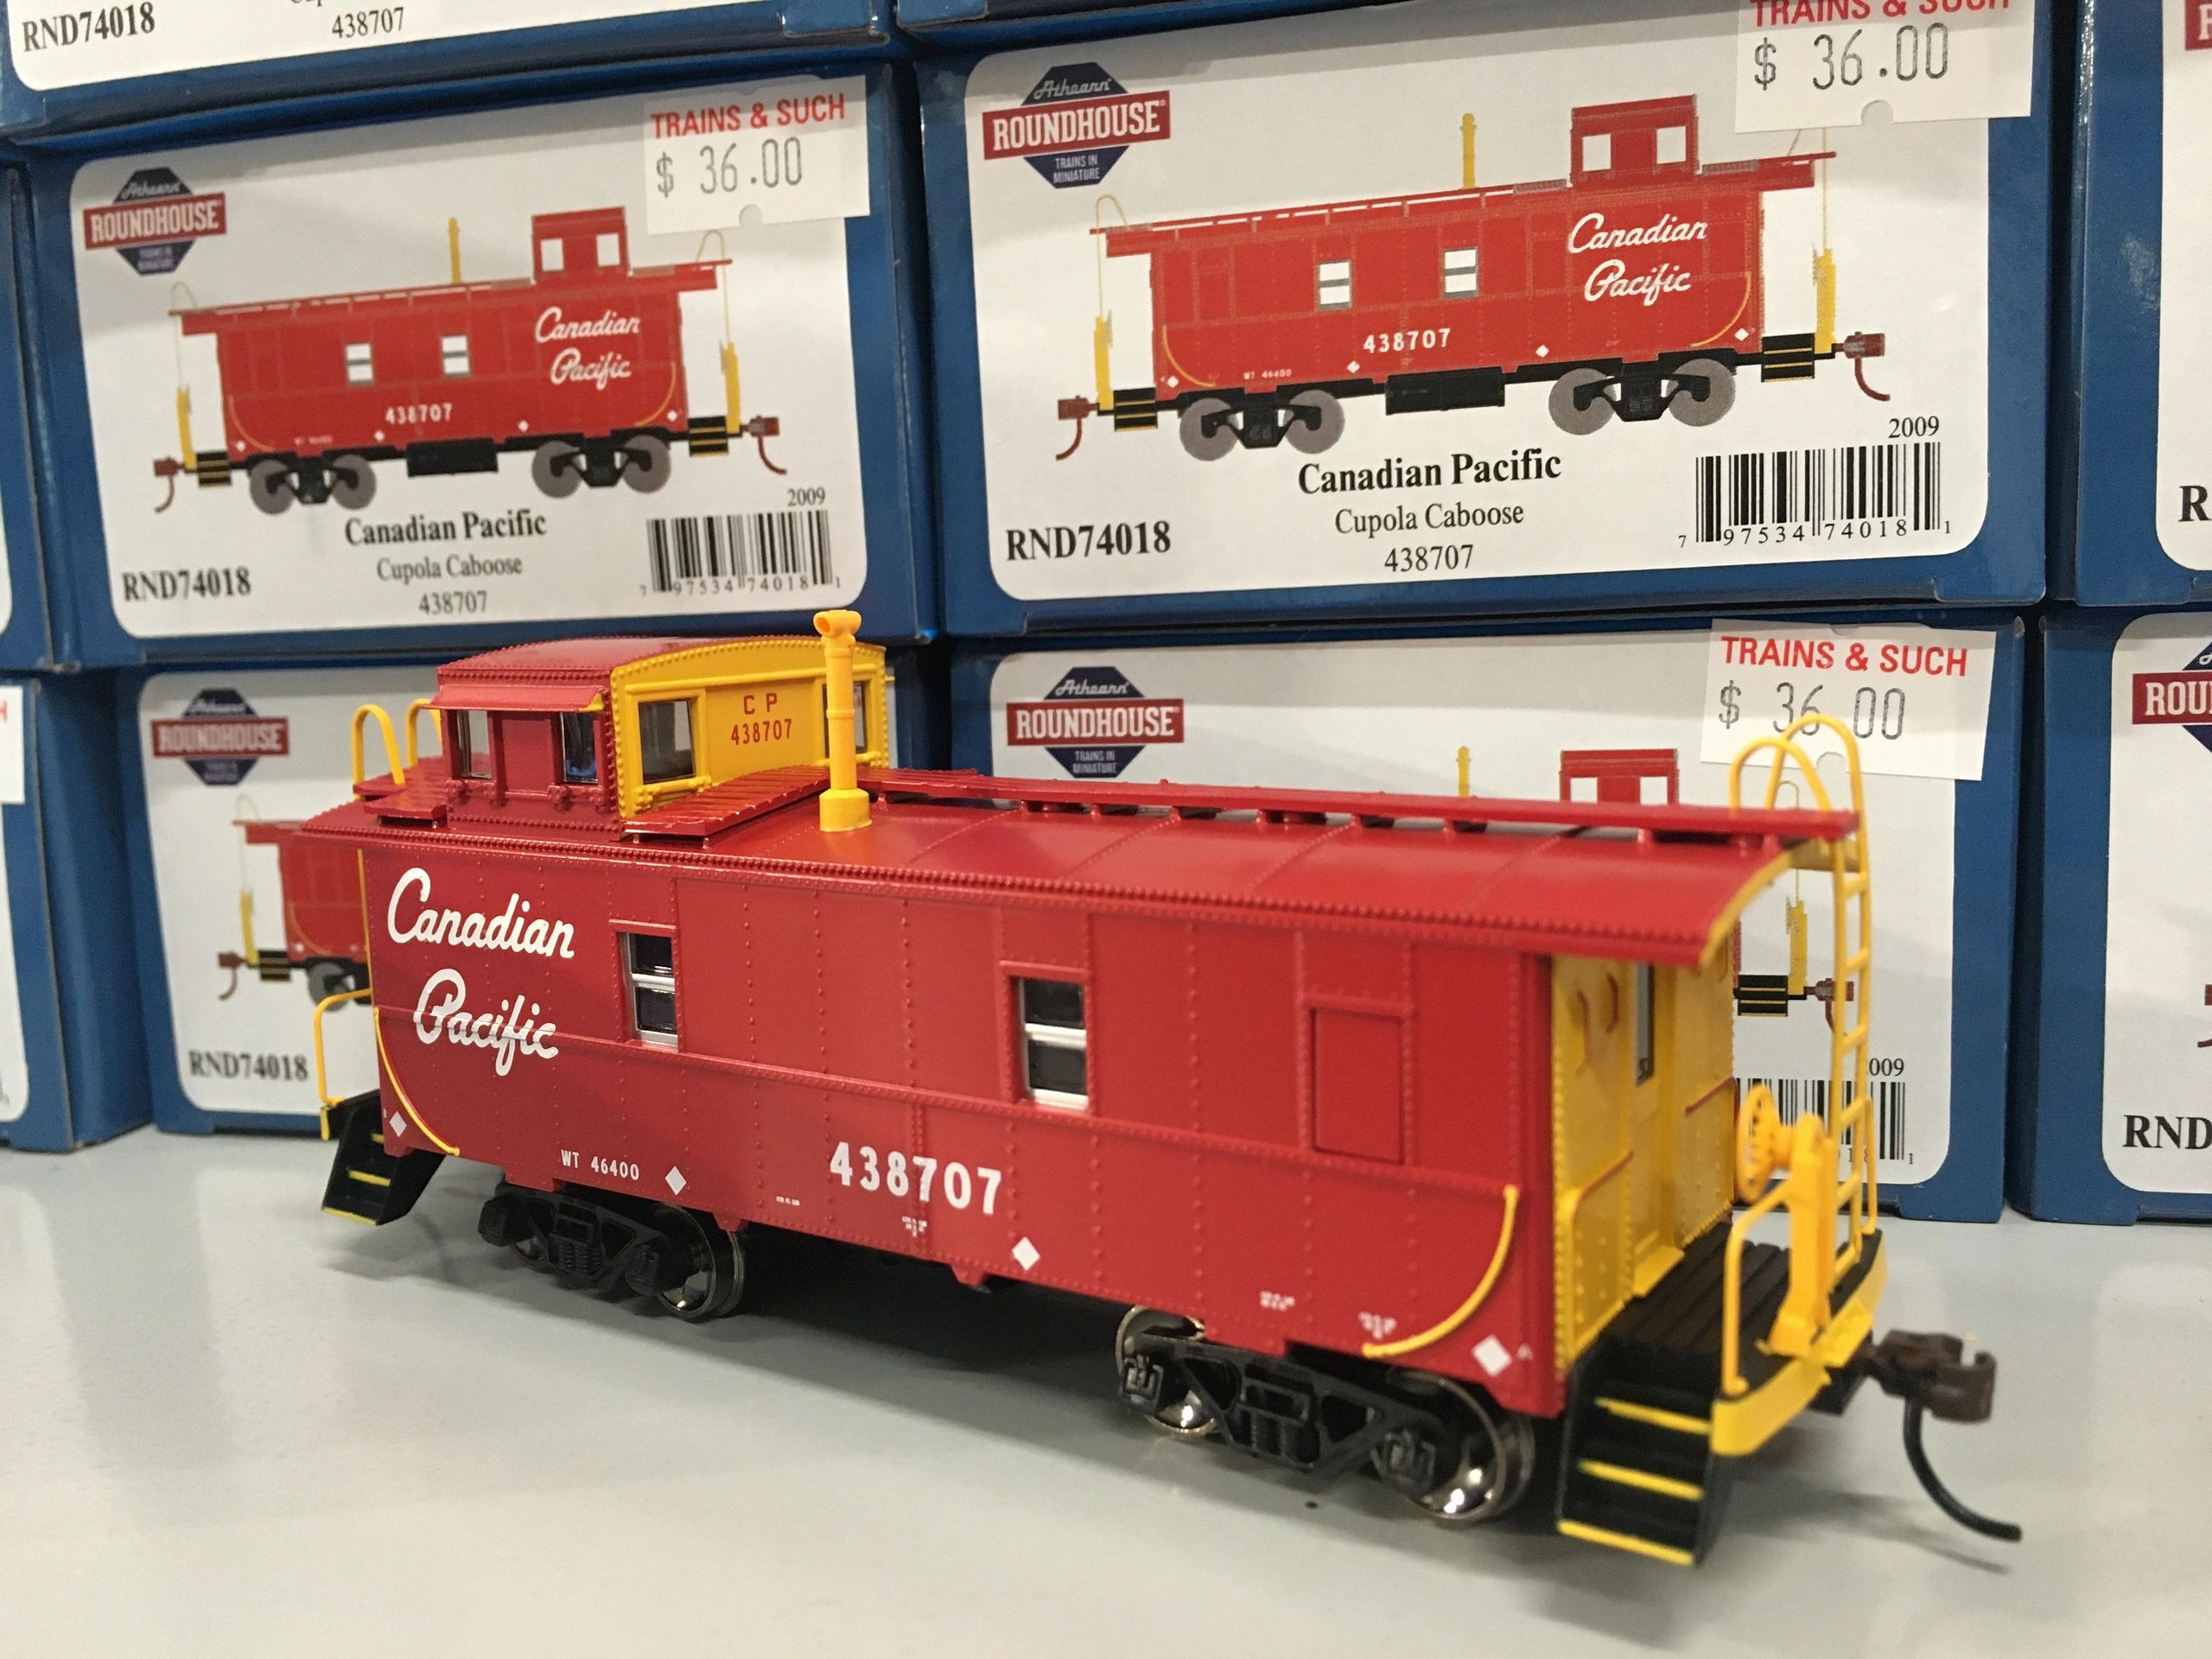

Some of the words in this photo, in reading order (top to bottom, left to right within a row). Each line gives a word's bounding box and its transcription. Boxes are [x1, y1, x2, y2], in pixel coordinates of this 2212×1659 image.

[22, 1, 156, 52] RND74018
[332, 7, 404, 38] 438707
[1754, 37, 1776, 91] $
[1813, 22, 1948, 90] 36.00
[651, 104, 741, 138] TRAINS
[750, 102, 768, 129] &
[778, 93, 845, 124] SUCH
[993, 100, 1160, 151] ROUNDHOUSE
[657, 152, 675, 198] $
[700, 137, 803, 194] 36.00
[1053, 168, 1100, 183] MINIATURE
[1055, 156, 1086, 169] TRAINS
[1088, 154, 1098, 166] IN
[90, 200, 220, 244] ROUNDHOUSE
[1568, 213, 1708, 254] Canadian
[1585, 259, 1693, 306] Pacific
[535, 307, 640, 343] Canadian
[1363, 328, 1451, 354] 438707
[550, 347, 632, 390] Pacific
[385, 403, 454, 426] 438707
[1889, 416, 1940, 439] 2009
[1298, 454, 1442, 493] Canadian
[1452, 448, 1562, 484] Pacific
[787, 488, 826, 508] 2009
[345, 516, 457, 547] Canadian
[463, 509, 547, 539] Pacific
[1335, 507, 1418, 538] Cupola
[1425, 502, 1524, 529] Caboose
[1723, 522, 1805, 546] 97534
[1824, 519, 1907, 542] 74018
[1007, 521, 1172, 562] RND74018
[1384, 544, 1474, 572] 438707
[121, 567, 251, 602] RND74018
[378, 556, 442, 584] Cupola
[446, 554, 522, 579] Caboose
[419, 590, 488, 615] 438707
[1721, 636, 1834, 669] TRAINS
[1846, 643, 1868, 671] &
[1880, 645, 1967, 677] SUCH
[743, 694, 755, 715] C
[766, 692, 778, 713] P
[1719, 680, 1741, 729] $
[731, 718, 792, 746] 438707
[1016, 707, 1175, 740] ROUNDHOUSE
[1075, 750, 1104, 761] TRAINS
[1106, 750, 1116, 760] IN
[387, 868, 575, 958] Canadian
[412, 968, 559, 1076] Pacific
[189, 1049, 308, 1083] RND74018
[1868, 1058, 1904, 1077] 009
[561, 1149, 579, 1168] WT
[591, 1155, 639, 1181] 46400
[830, 1141, 1002, 1216] 438707
